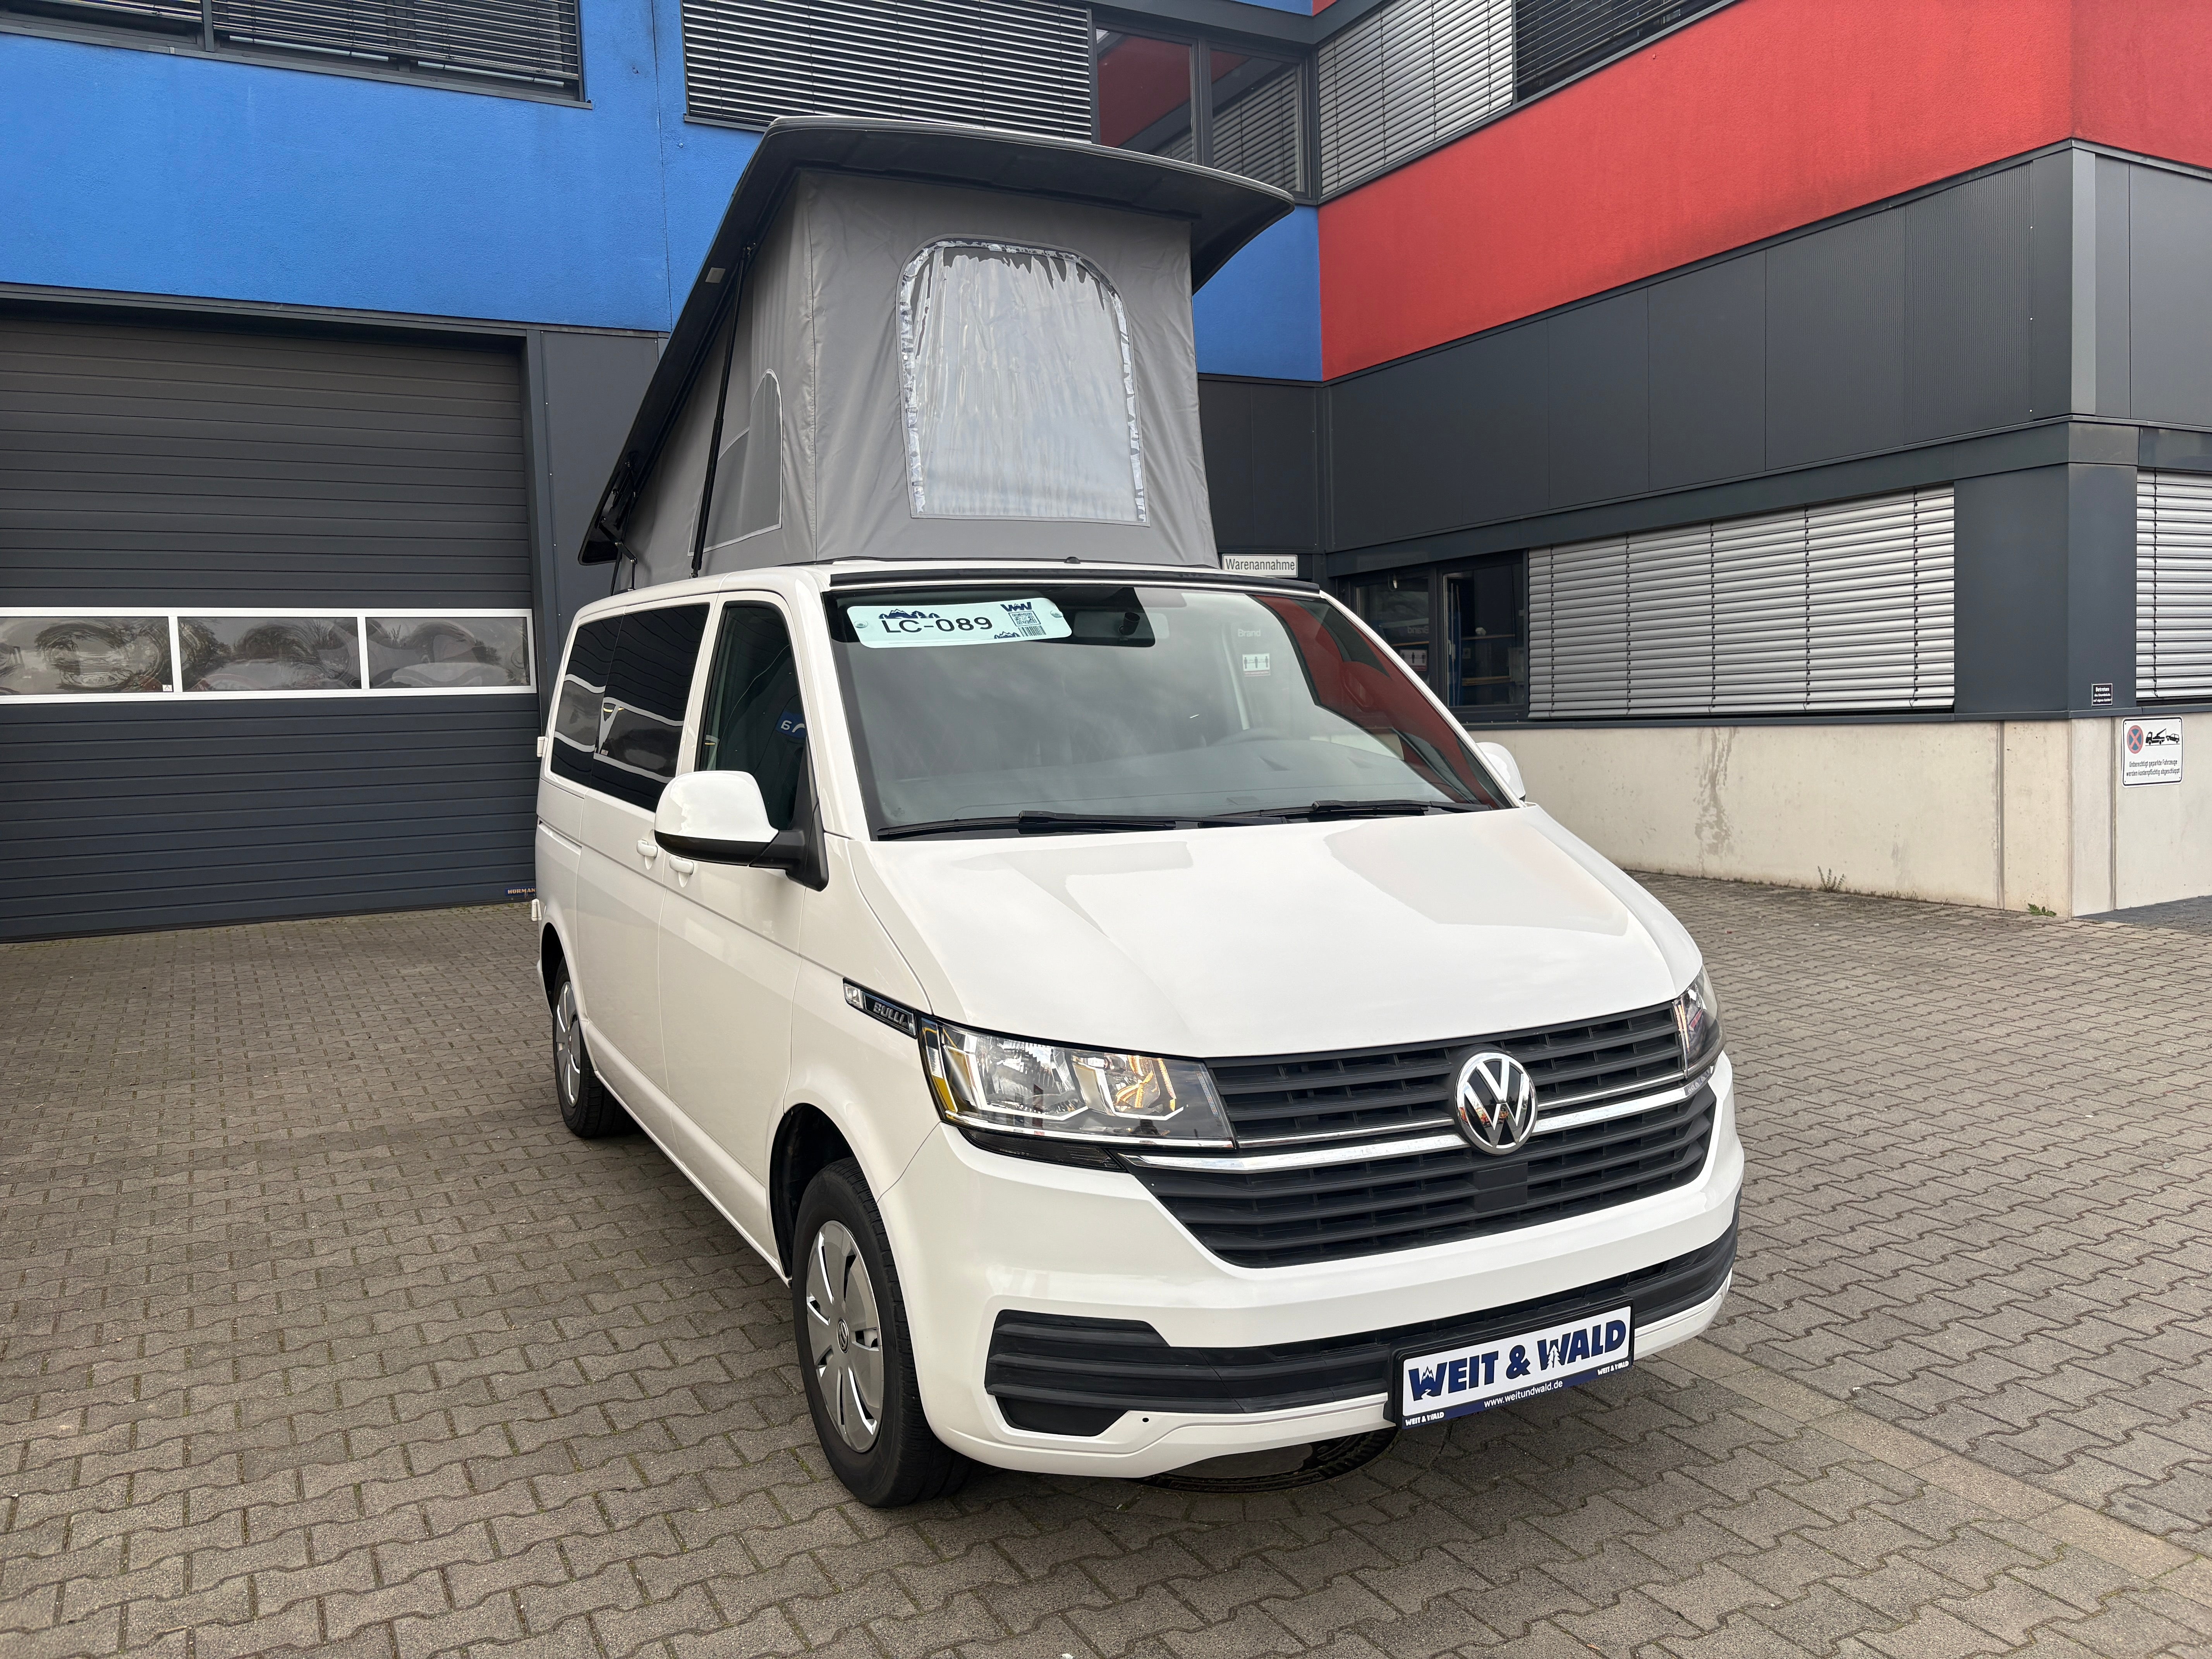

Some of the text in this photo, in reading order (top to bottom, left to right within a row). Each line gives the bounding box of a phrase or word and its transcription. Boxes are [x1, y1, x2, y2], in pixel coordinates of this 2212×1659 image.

[1225, 558, 1295, 570] Warenannahme
[881, 617, 993, 634] LC-089
[873, 1002, 905, 1024] BULLI
[1408, 1319, 1626, 1401] WEIT & WALD
[1597, 1366, 1610, 1375] WEIT
[1615, 1360, 1629, 1370] WALD
[1484, 1380, 1563, 1408] www.weitundwald.de
[1405, 1417, 1420, 1426] WEIT
[1427, 1412, 1444, 1421] WALD
